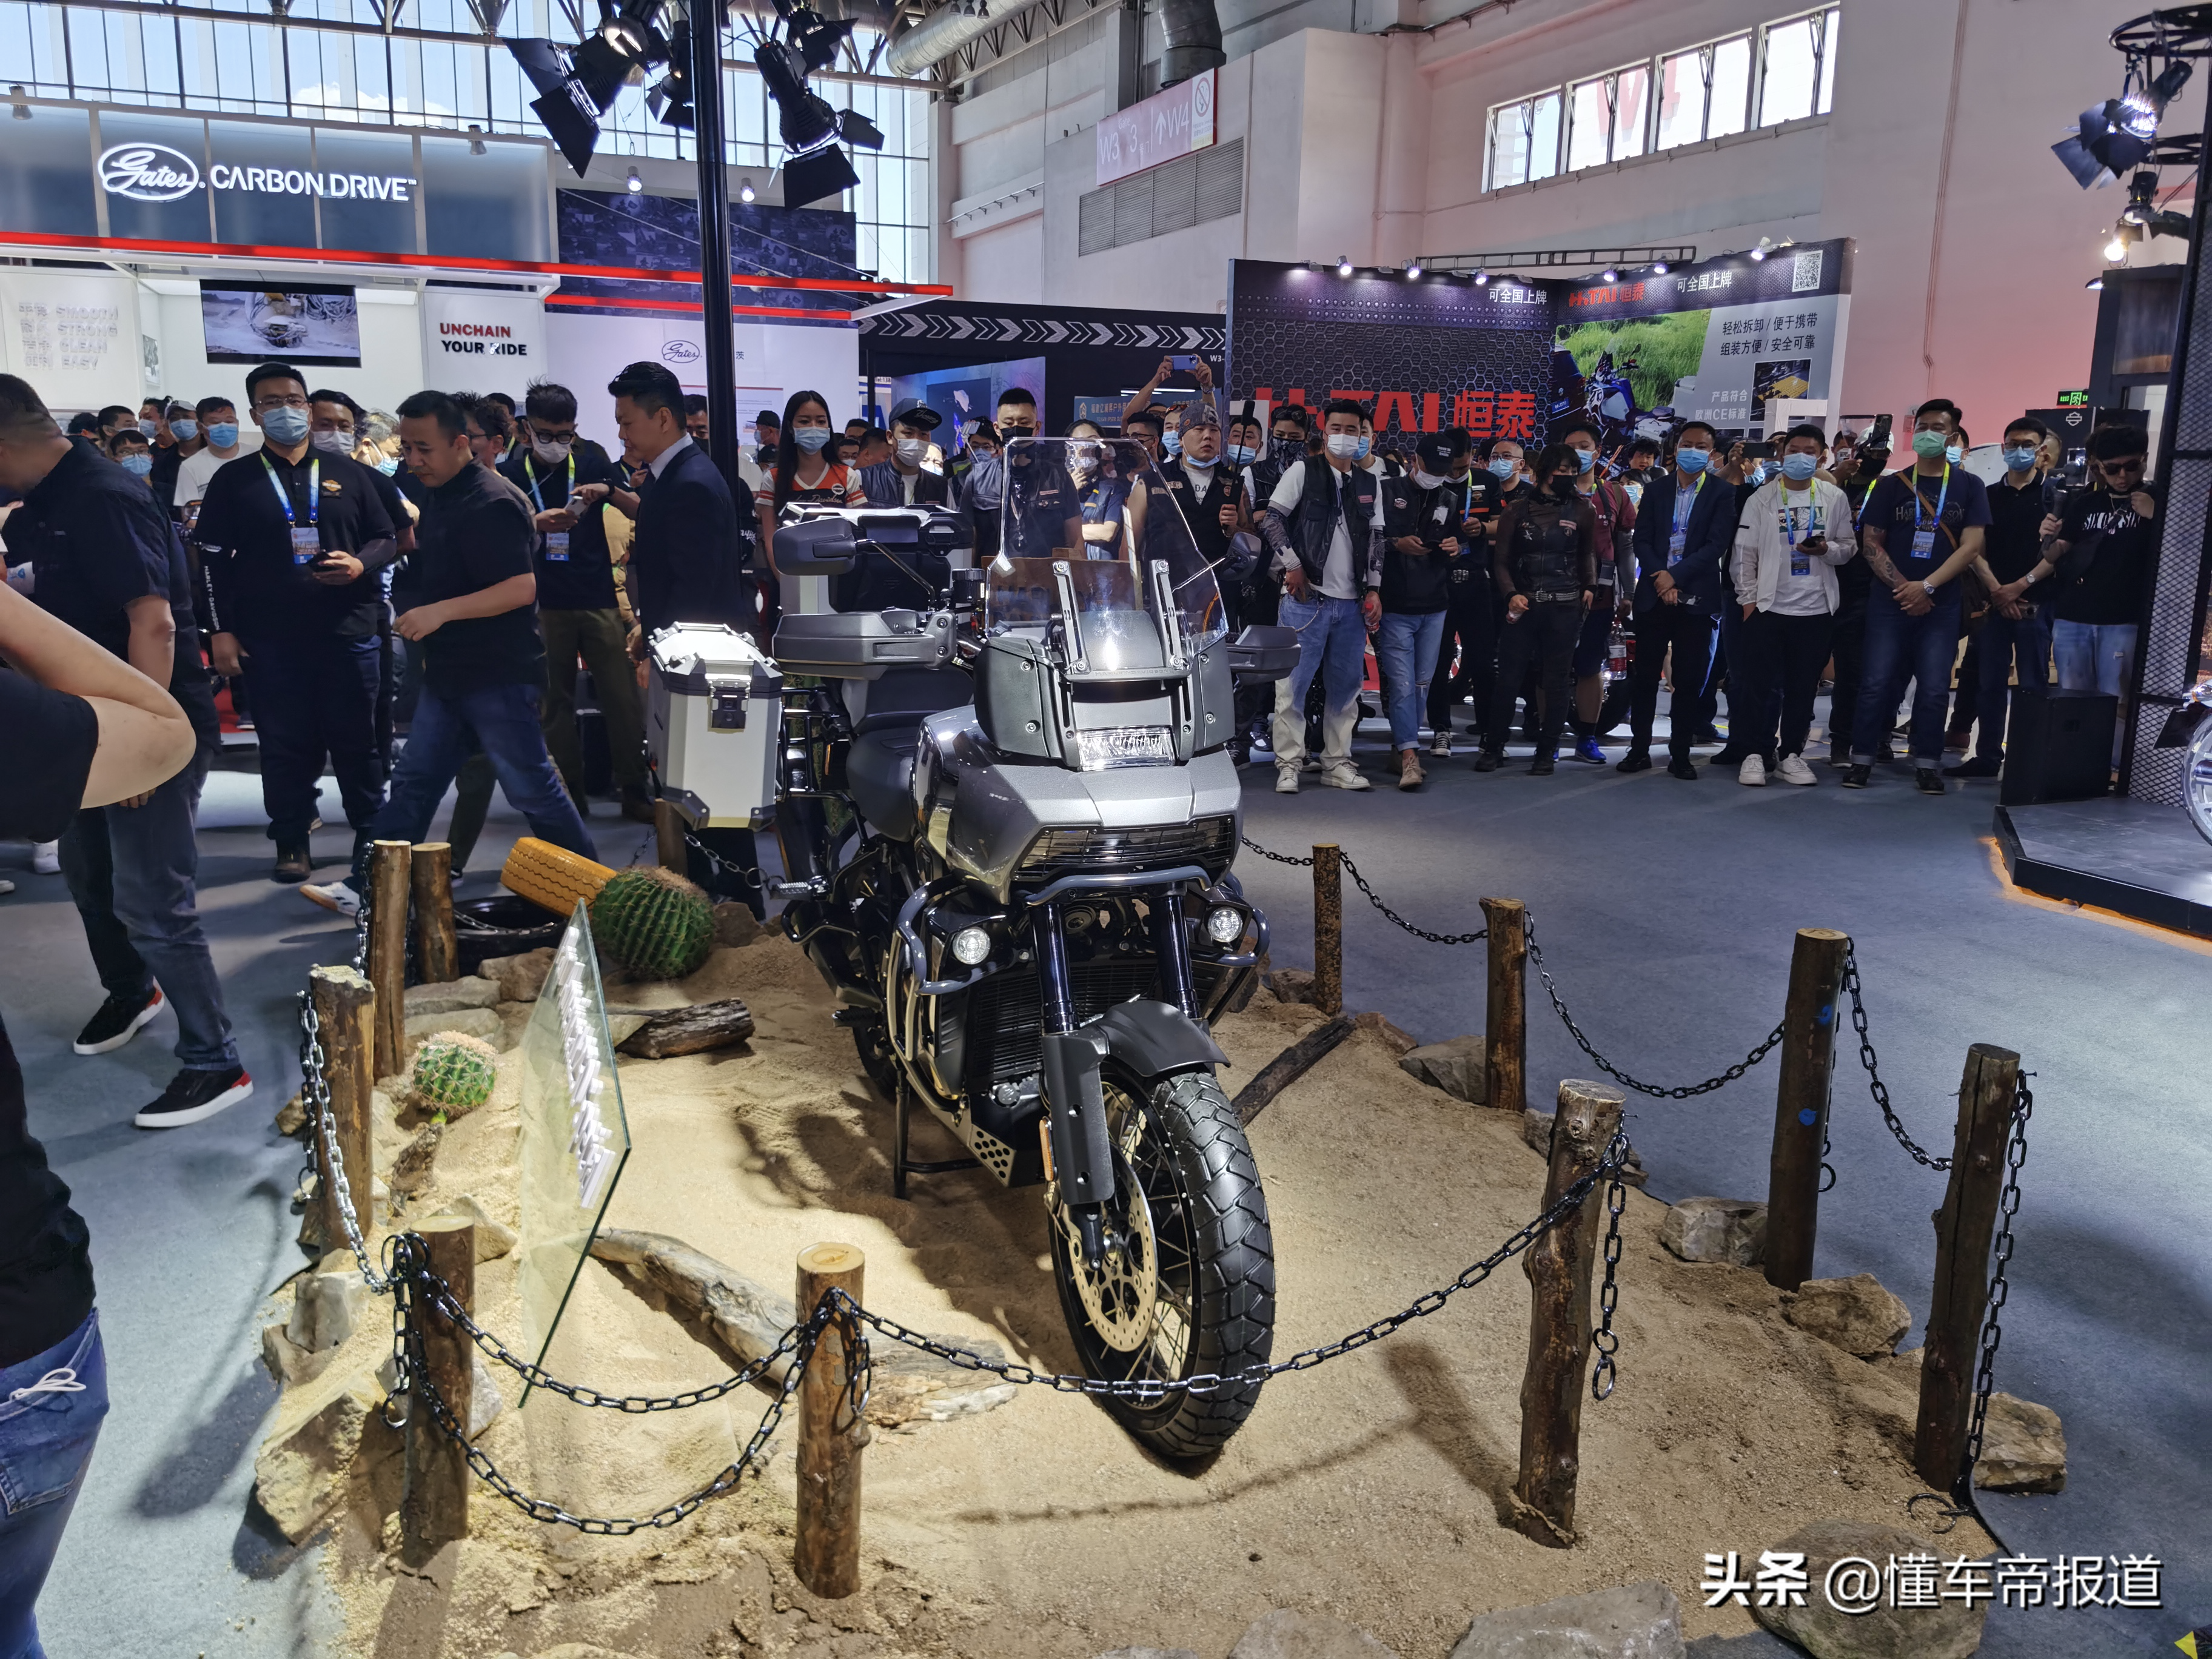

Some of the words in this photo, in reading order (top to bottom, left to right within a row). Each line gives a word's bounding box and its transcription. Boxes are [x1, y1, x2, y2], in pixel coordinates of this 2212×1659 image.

[1167, 101, 1190, 138] W4
[1099, 132, 1119, 165] W3
[102, 150, 193, 193] Gates
[210, 164, 324, 196] CARBON
[1677, 272, 1732, 293] 可全国上牌
[1489, 287, 1547, 305] 可全国上牌
[56, 306, 119, 320] SMOOTH
[58, 321, 118, 337] STRONG
[440, 322, 511, 338] UNCHAIN
[59, 338, 108, 354] CLEAN
[441, 340, 484, 354] YOUR
[489, 342, 528, 356] RIDE
[663, 343, 699, 361] Gates
[62, 354, 99, 370] EASY
[1711, 389, 1748, 403] 产品符合
[1454, 390, 1534, 438] 恒泰
[1695, 407, 1746, 421] 欧洲CE标准
